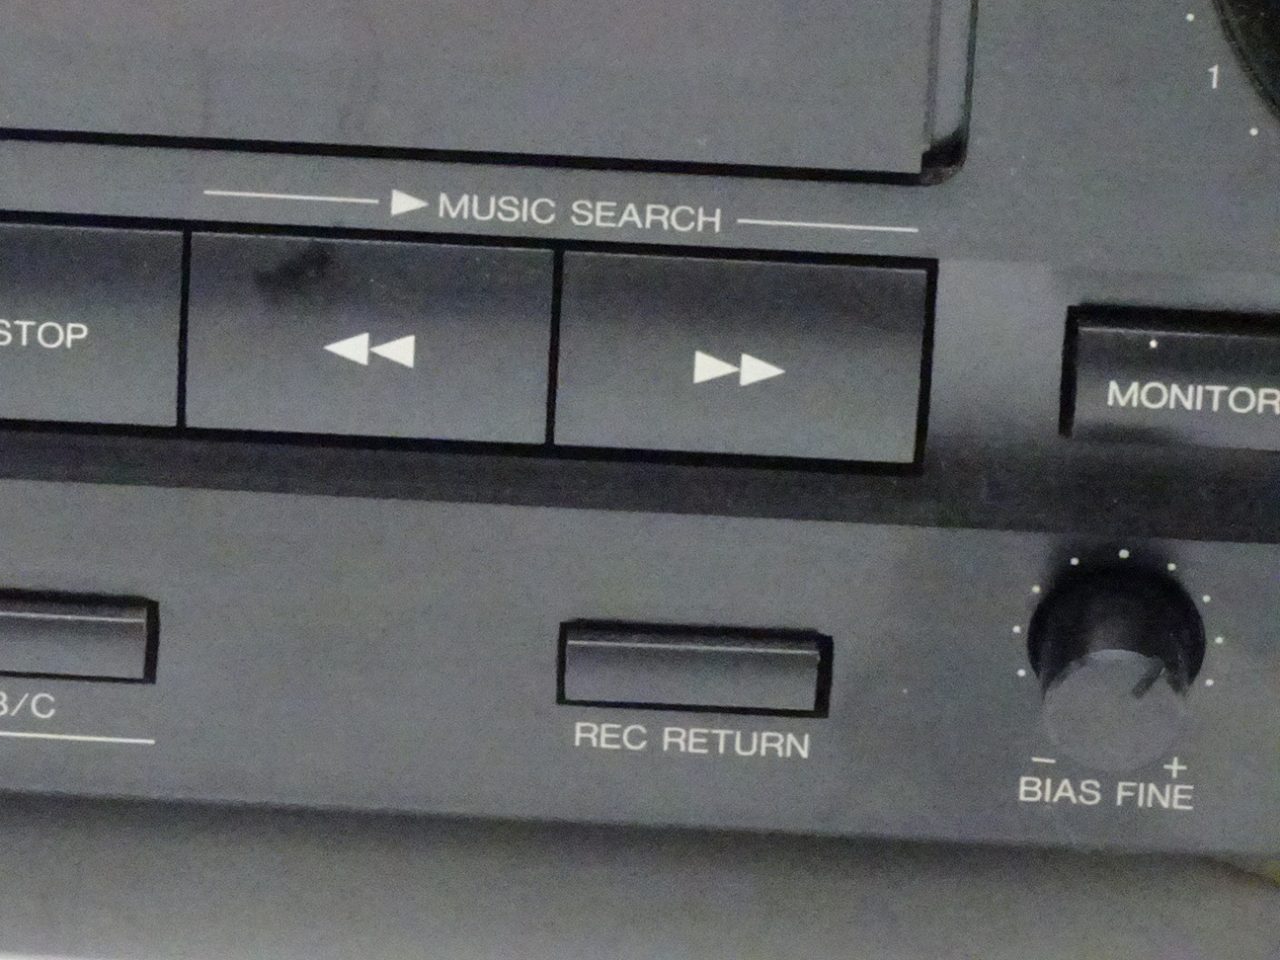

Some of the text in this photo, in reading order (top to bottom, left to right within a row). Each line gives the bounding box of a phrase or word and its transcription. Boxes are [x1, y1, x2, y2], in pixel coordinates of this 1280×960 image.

[1208, 64, 1219, 89] 1
[438, 192, 721, 233] MUSIC SEARCH
[1107, 380, 1280, 415] MONITOR
[574, 721, 809, 759] REC RETURN
[1018, 776, 1194, 810] BIAS FINE
